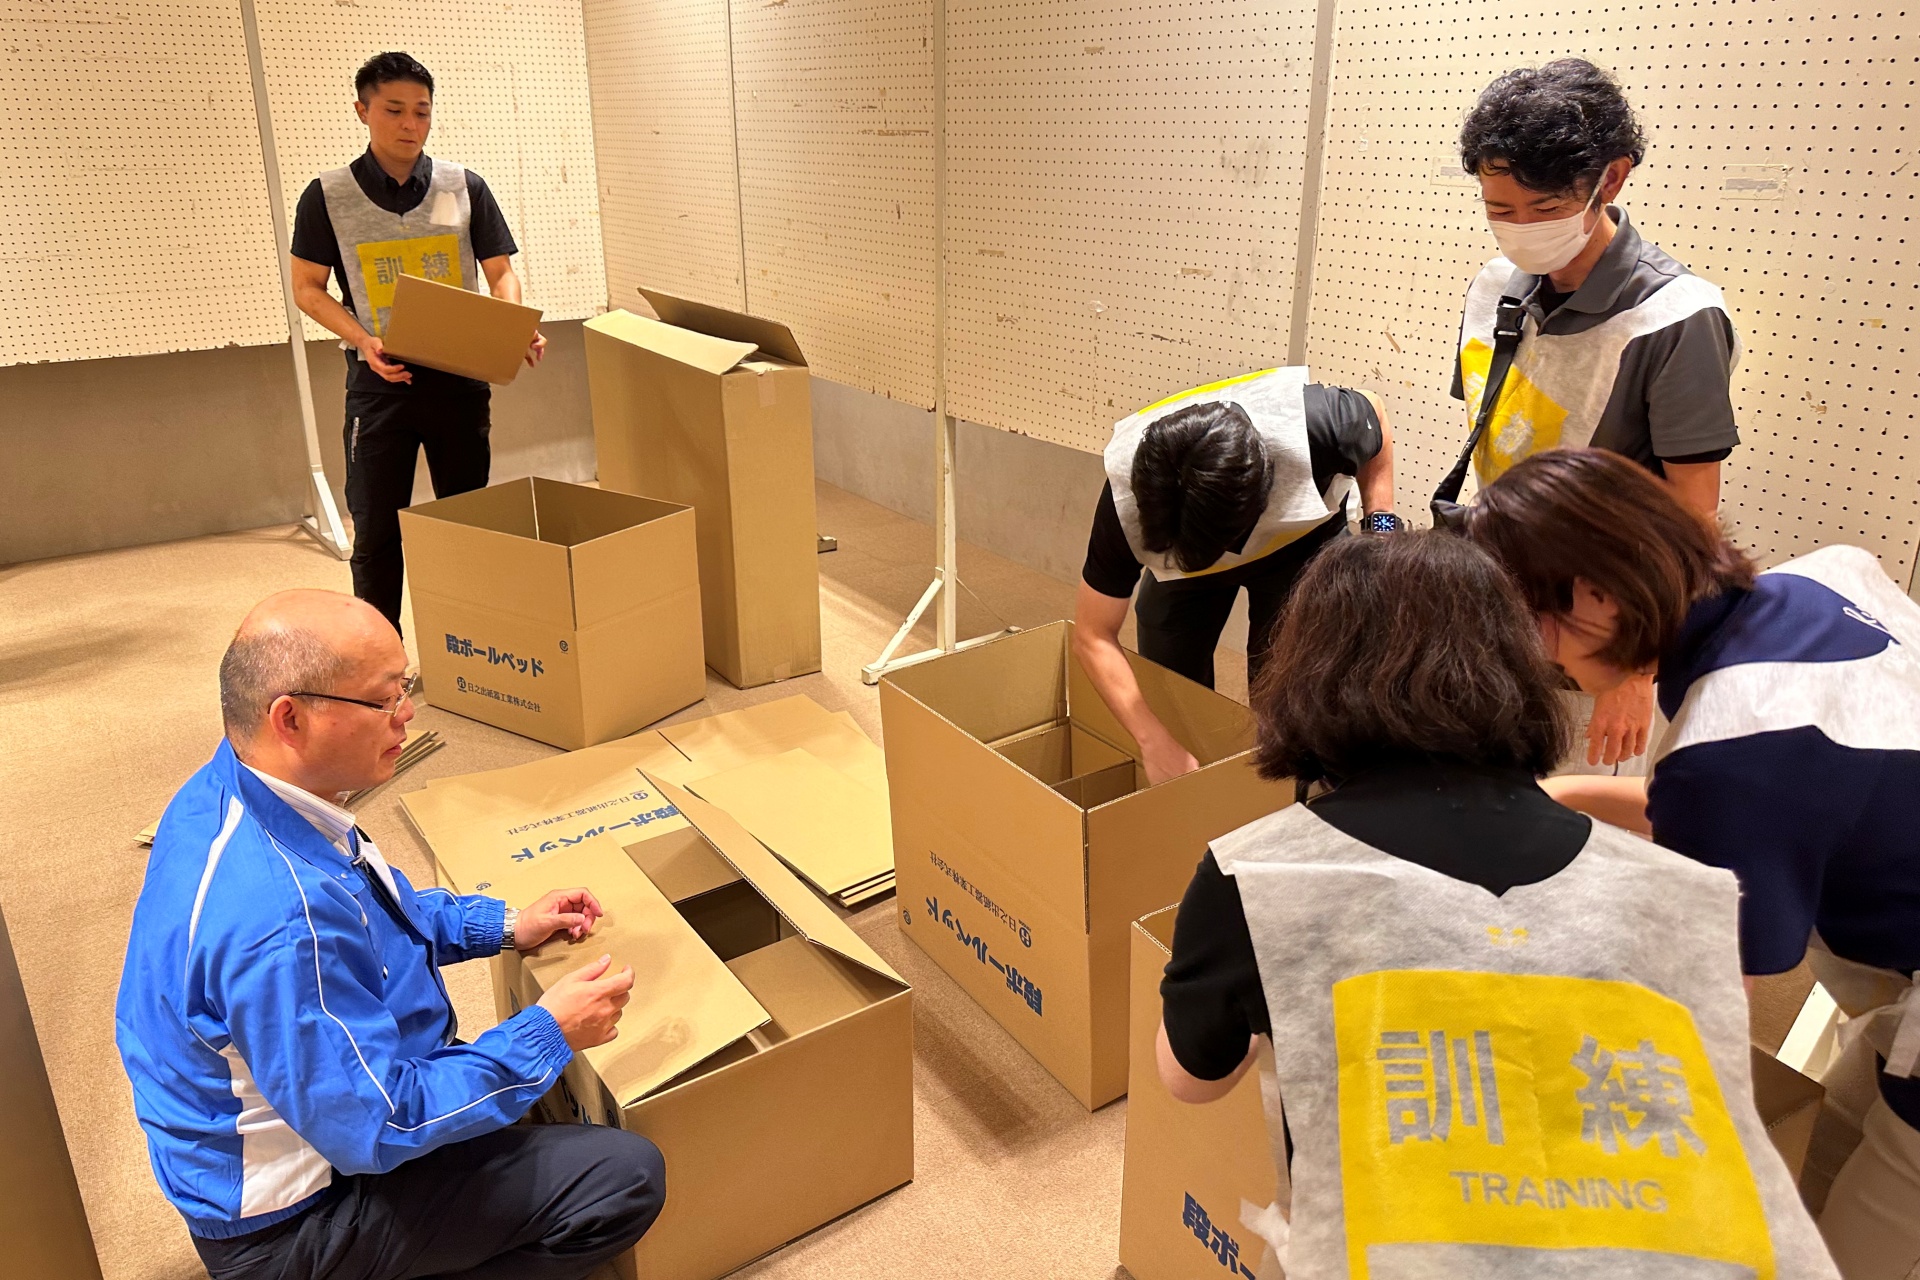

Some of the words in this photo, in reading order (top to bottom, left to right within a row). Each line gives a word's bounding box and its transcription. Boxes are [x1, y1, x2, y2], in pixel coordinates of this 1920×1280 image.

[374, 251, 451, 285] 訓練
[445, 633, 544, 677] 段ボールベッド
[467, 682, 541, 713] 日之出紙器工業株式会社
[506, 796, 630, 836] 日之出紙器工業株式会社
[511, 804, 680, 863] 段ボールベッド
[929, 850, 1016, 932] 日之出紙器工業株式会社
[925, 896, 1042, 1017] 段ボールベッド
[1376, 1030, 1707, 1157] 訓練
[1448, 1171, 1669, 1213] TRAINING
